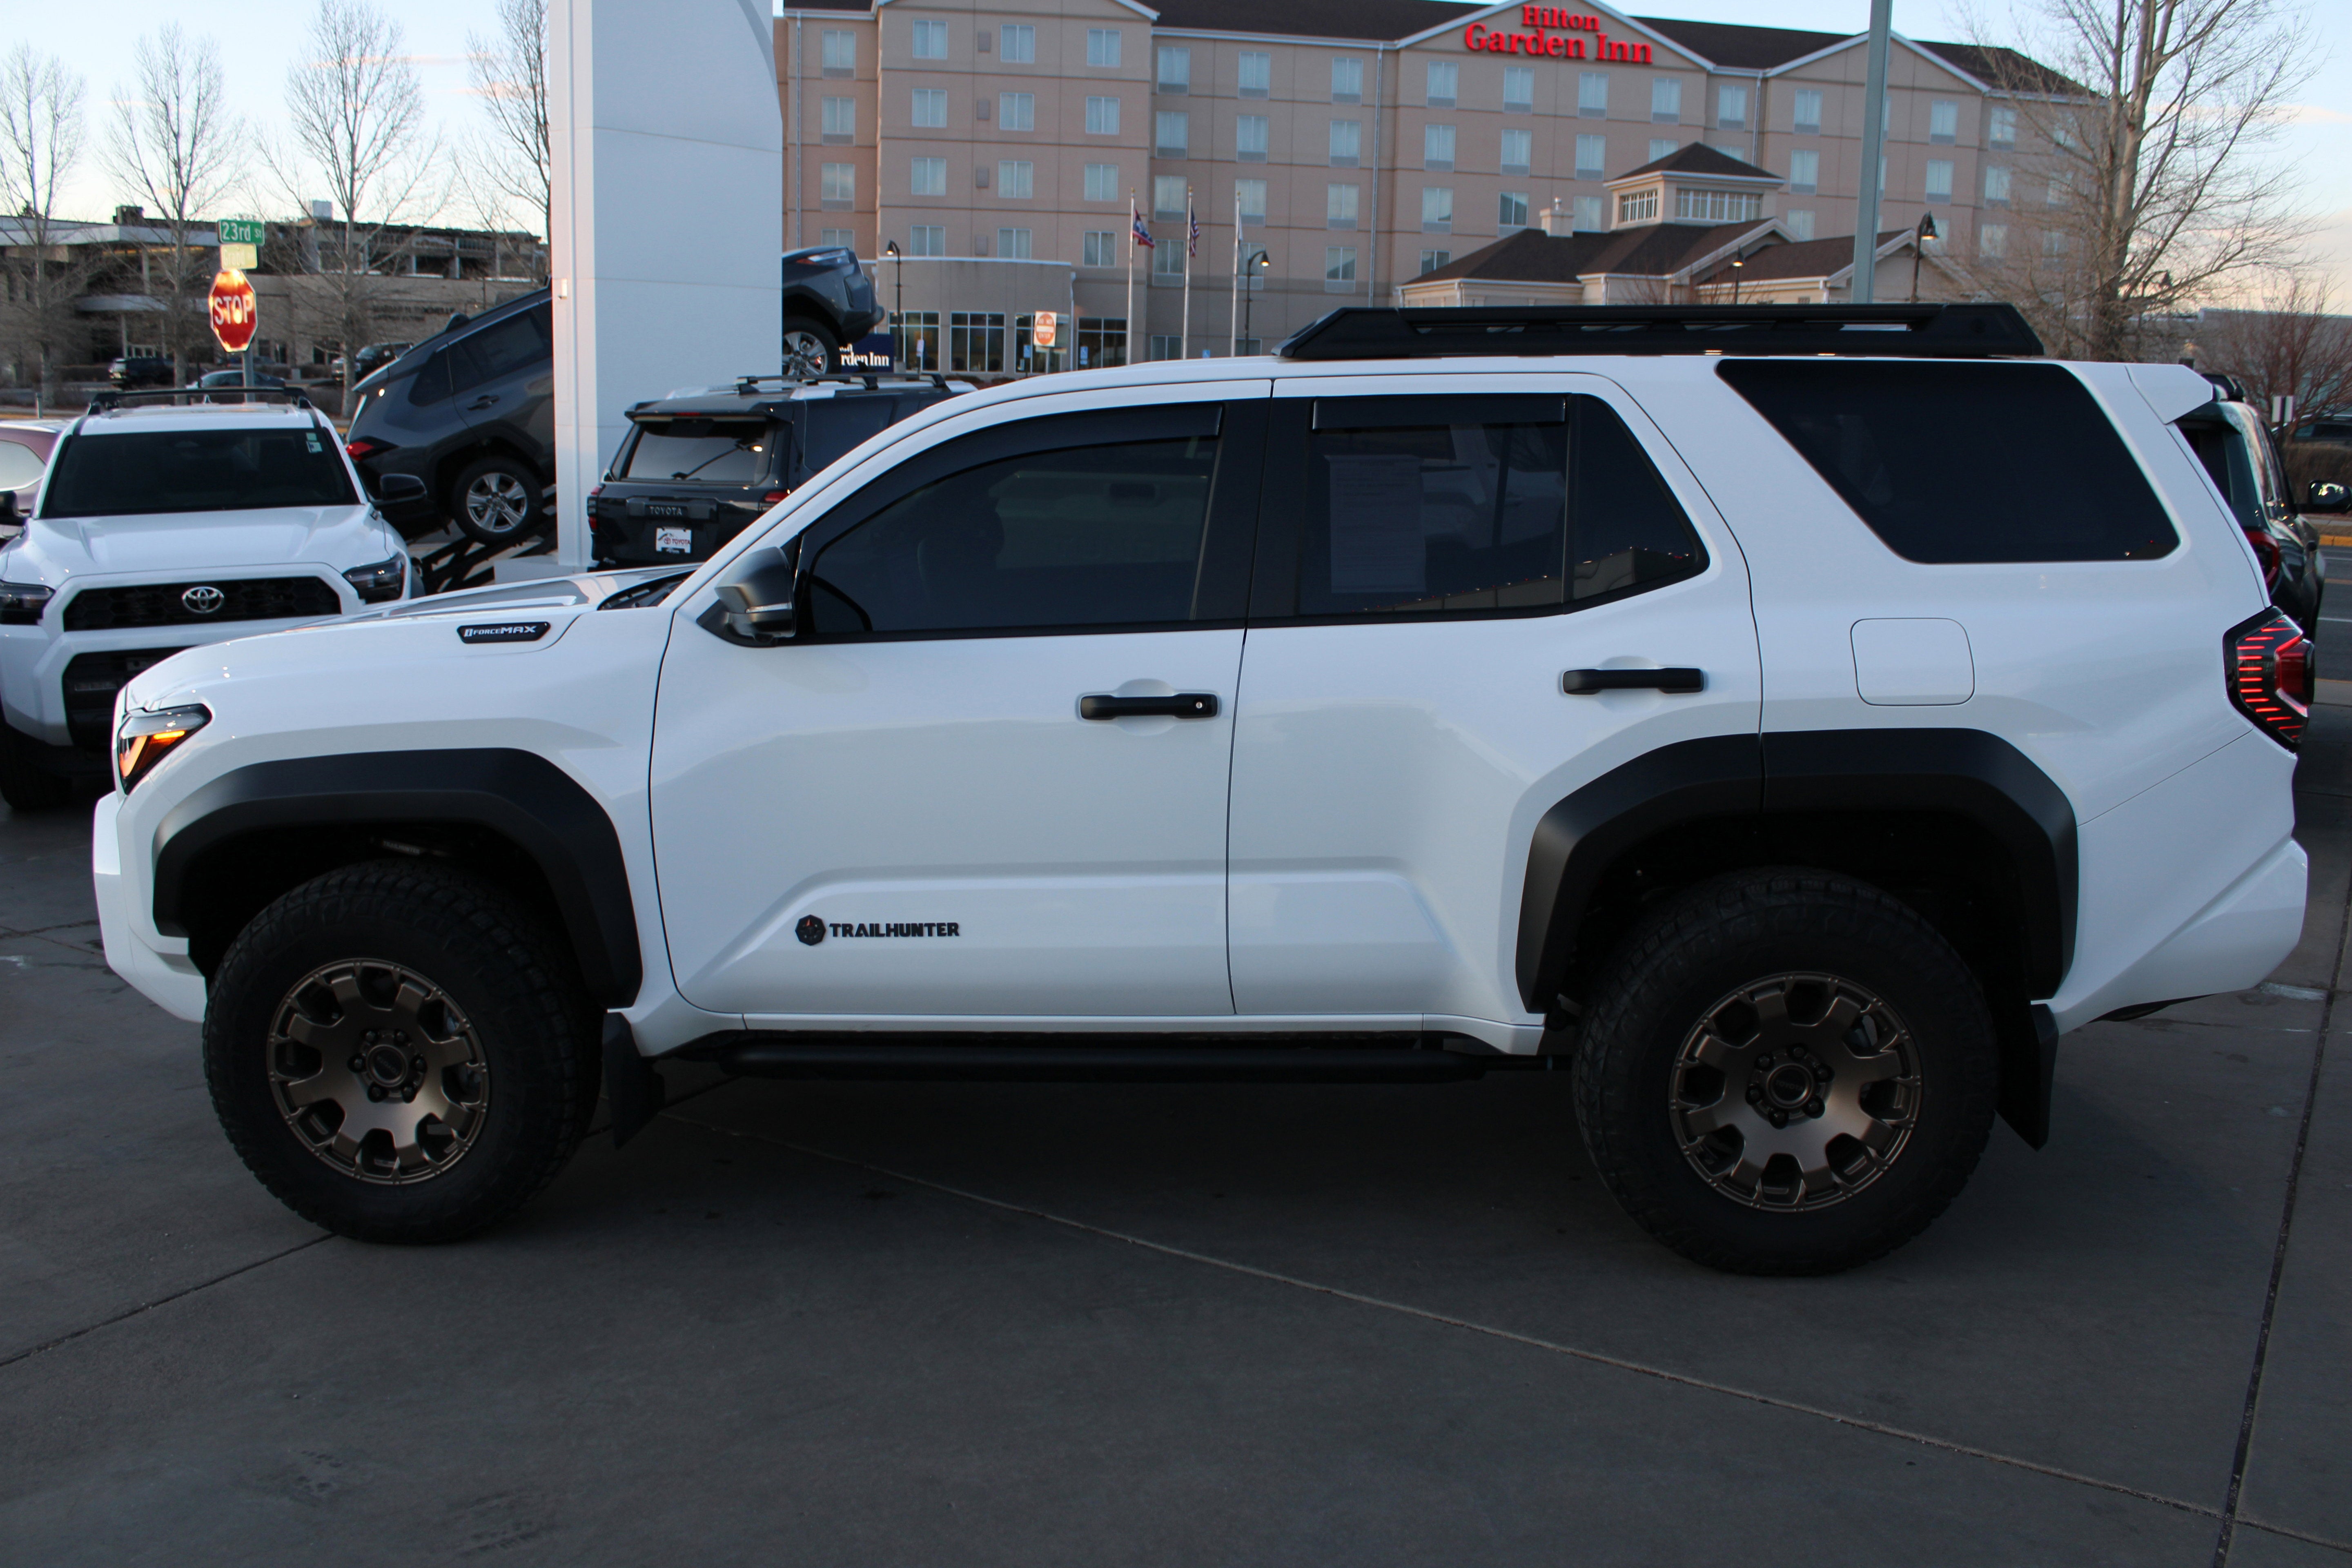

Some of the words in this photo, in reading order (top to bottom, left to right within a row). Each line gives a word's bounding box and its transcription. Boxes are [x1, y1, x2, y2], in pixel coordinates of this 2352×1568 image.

[1523, 5, 1600, 31] Hilton
[1464, 22, 1586, 58] Garden
[1596, 33, 1652, 63] Inn
[222, 221, 251, 241] 23rd
[214, 295, 253, 325] STOP
[869, 352, 889, 366] Inn
[650, 506, 682, 515] TOYOTA
[829, 922, 959, 937] TRAILHUNTER
